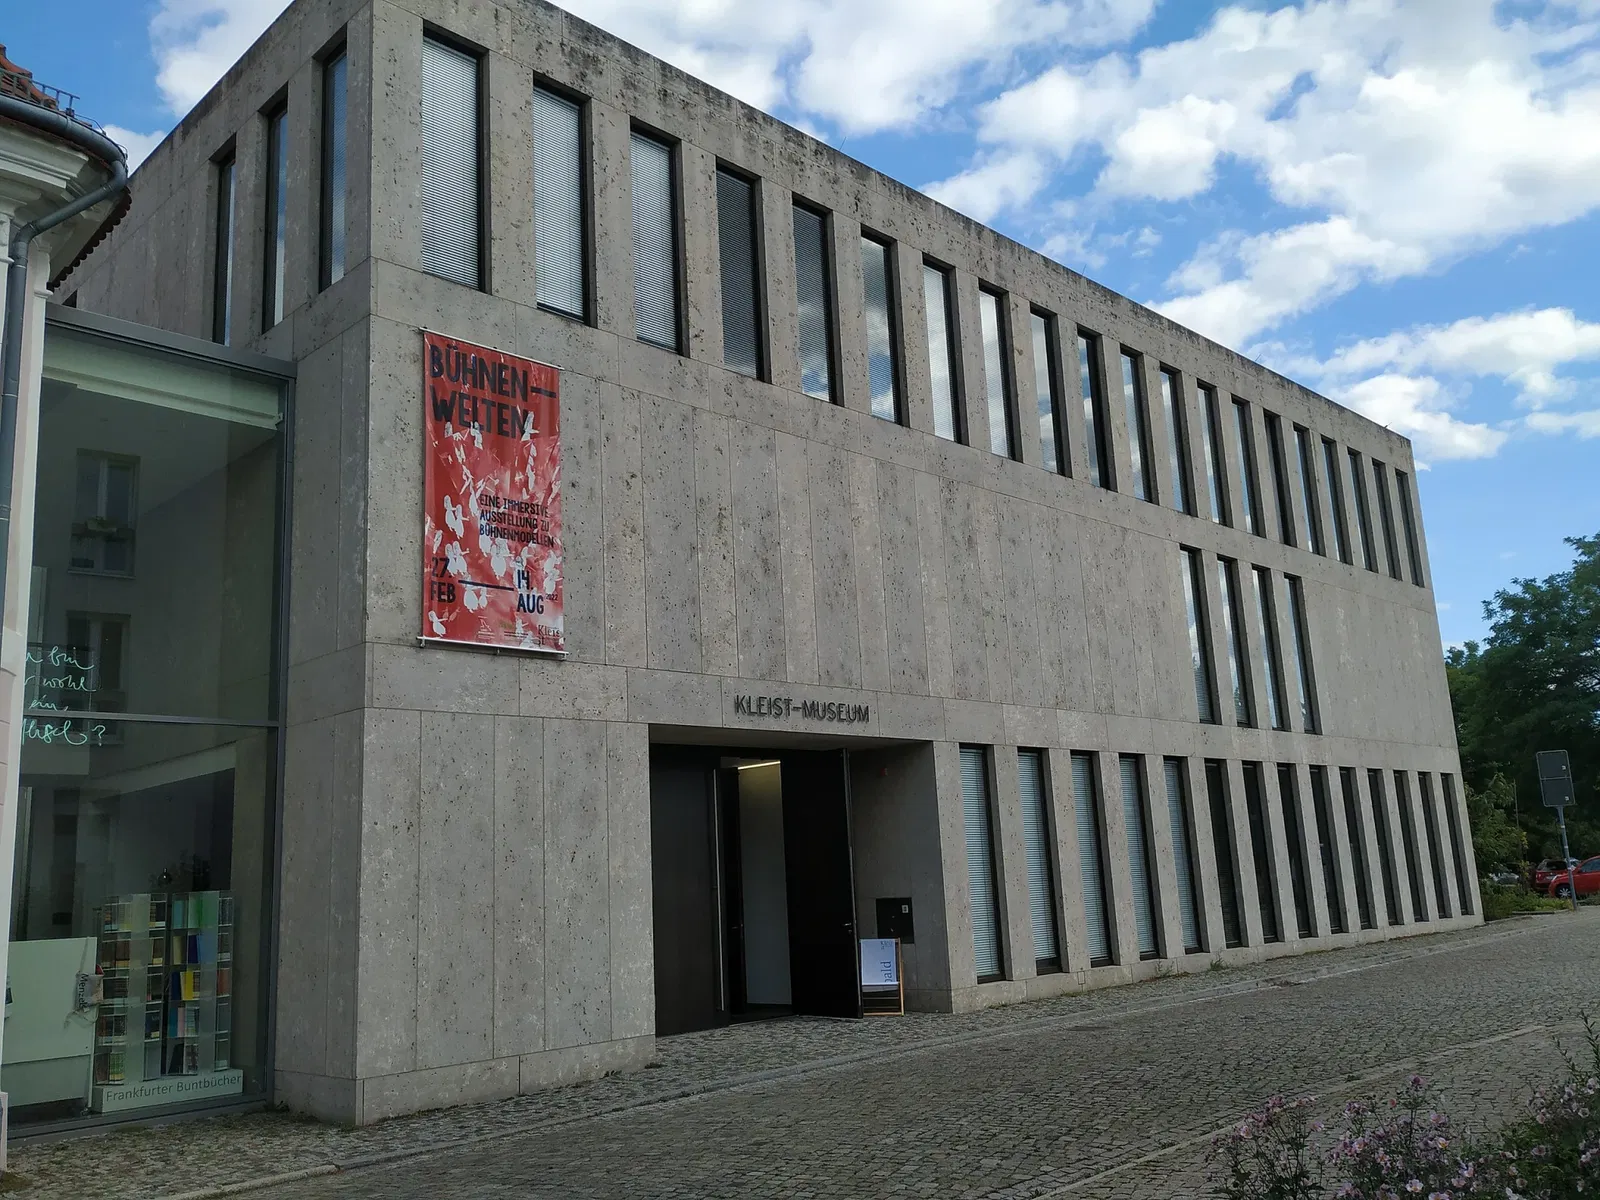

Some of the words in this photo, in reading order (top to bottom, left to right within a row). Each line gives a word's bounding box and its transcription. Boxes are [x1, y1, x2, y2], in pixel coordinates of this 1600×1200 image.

[430, 384, 530, 439] WELTEN
[480, 494, 500, 508] EINE
[503, 498, 549, 518] IMMERSIVE
[480, 509, 538, 529] AUSSTELLUNG
[541, 519, 549, 532] ZU
[480, 523, 555, 548] BÜHNENMODELLEN
[431, 580, 456, 603] FEB
[517, 593, 544, 614] AUG
[546, 593, 559, 601] 2022
[735, 695, 870, 724] KLEIST-MUSEUM
[106, 1083, 173, 1102] Frankfurter
[177, 1074, 242, 1092] Buntbücher
